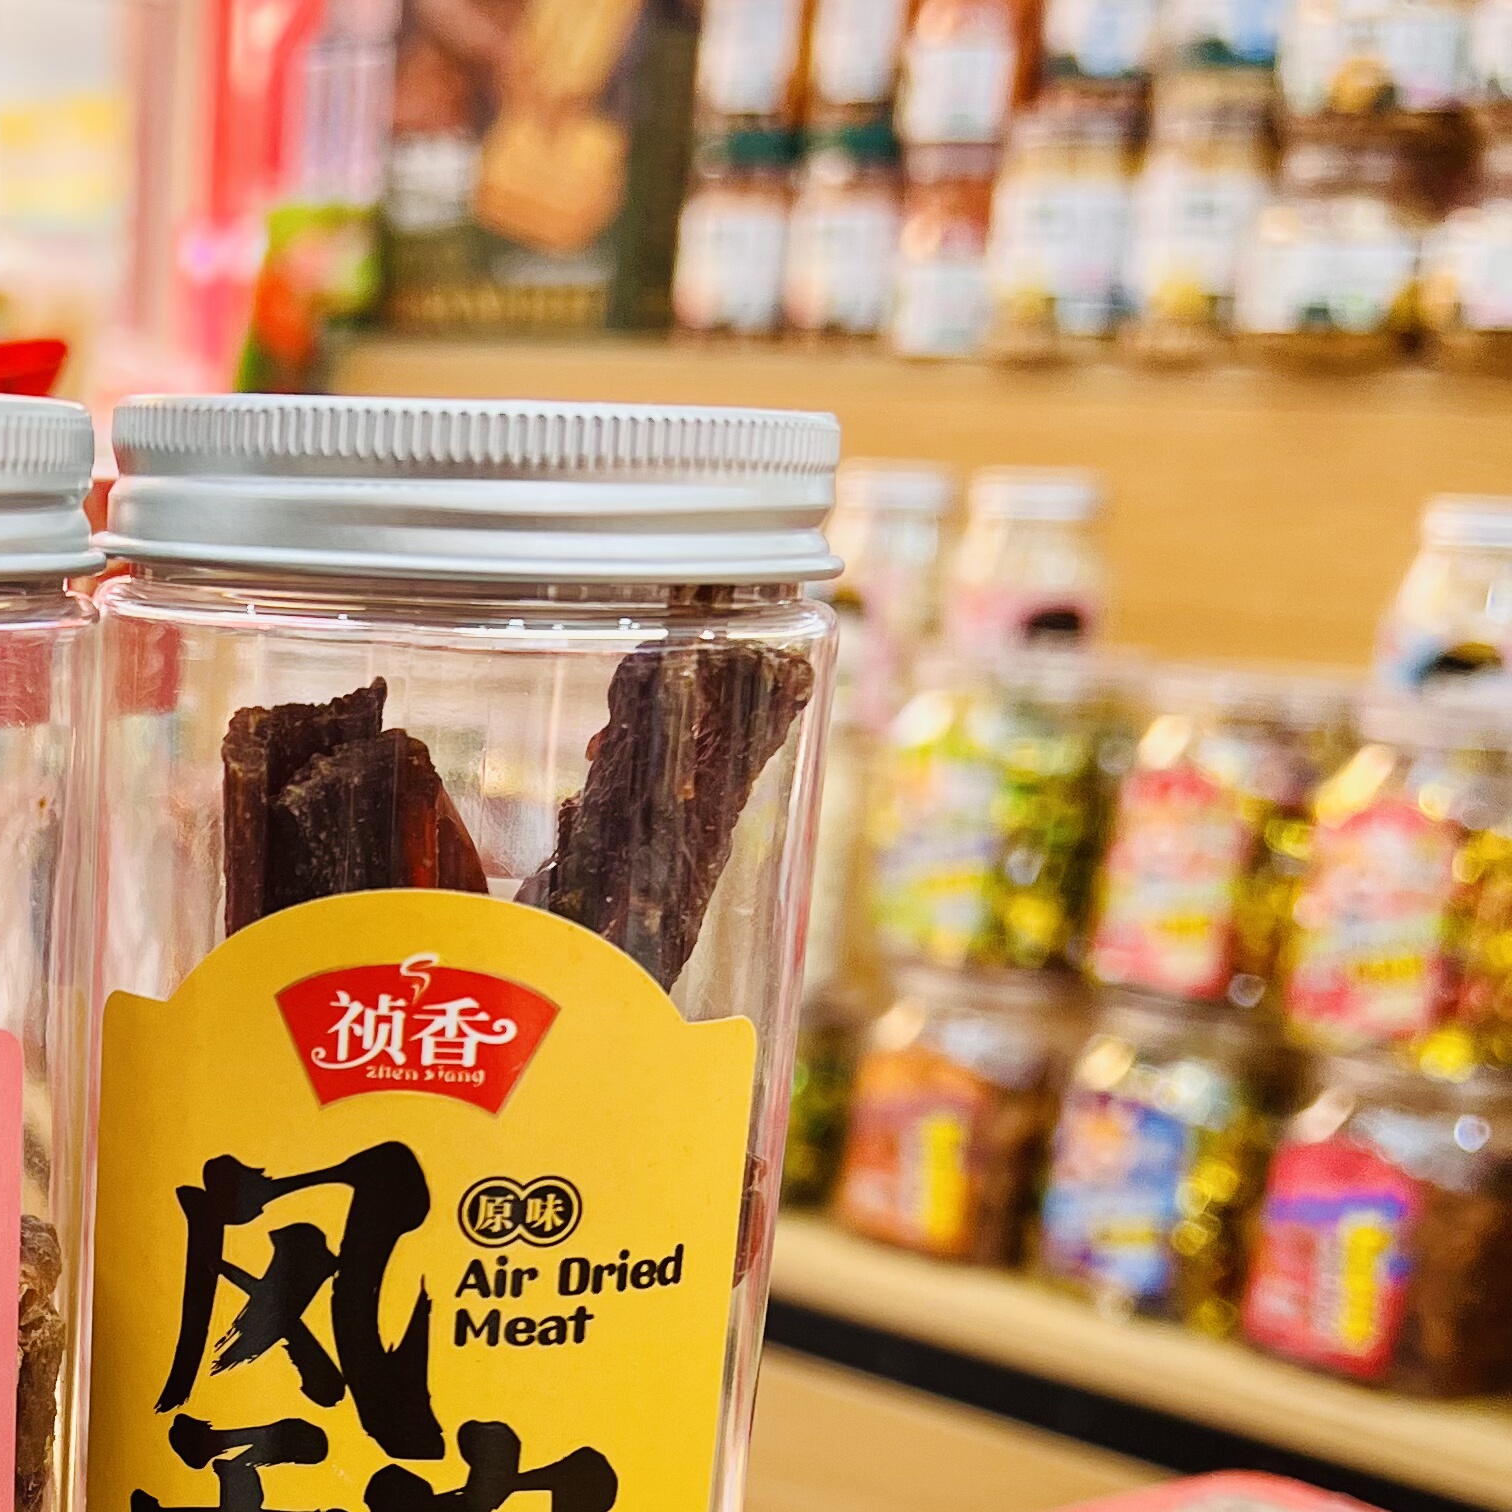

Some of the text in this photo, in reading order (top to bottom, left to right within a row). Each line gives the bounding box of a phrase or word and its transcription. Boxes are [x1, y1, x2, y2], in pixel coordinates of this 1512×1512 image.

[310, 989, 518, 1070] 祯香
[470, 1189, 571, 1236] 原味
[454, 1244, 684, 1299] Air Dried
[154, 1141, 445, 1461] 风
[454, 1306, 594, 1347] Meat
